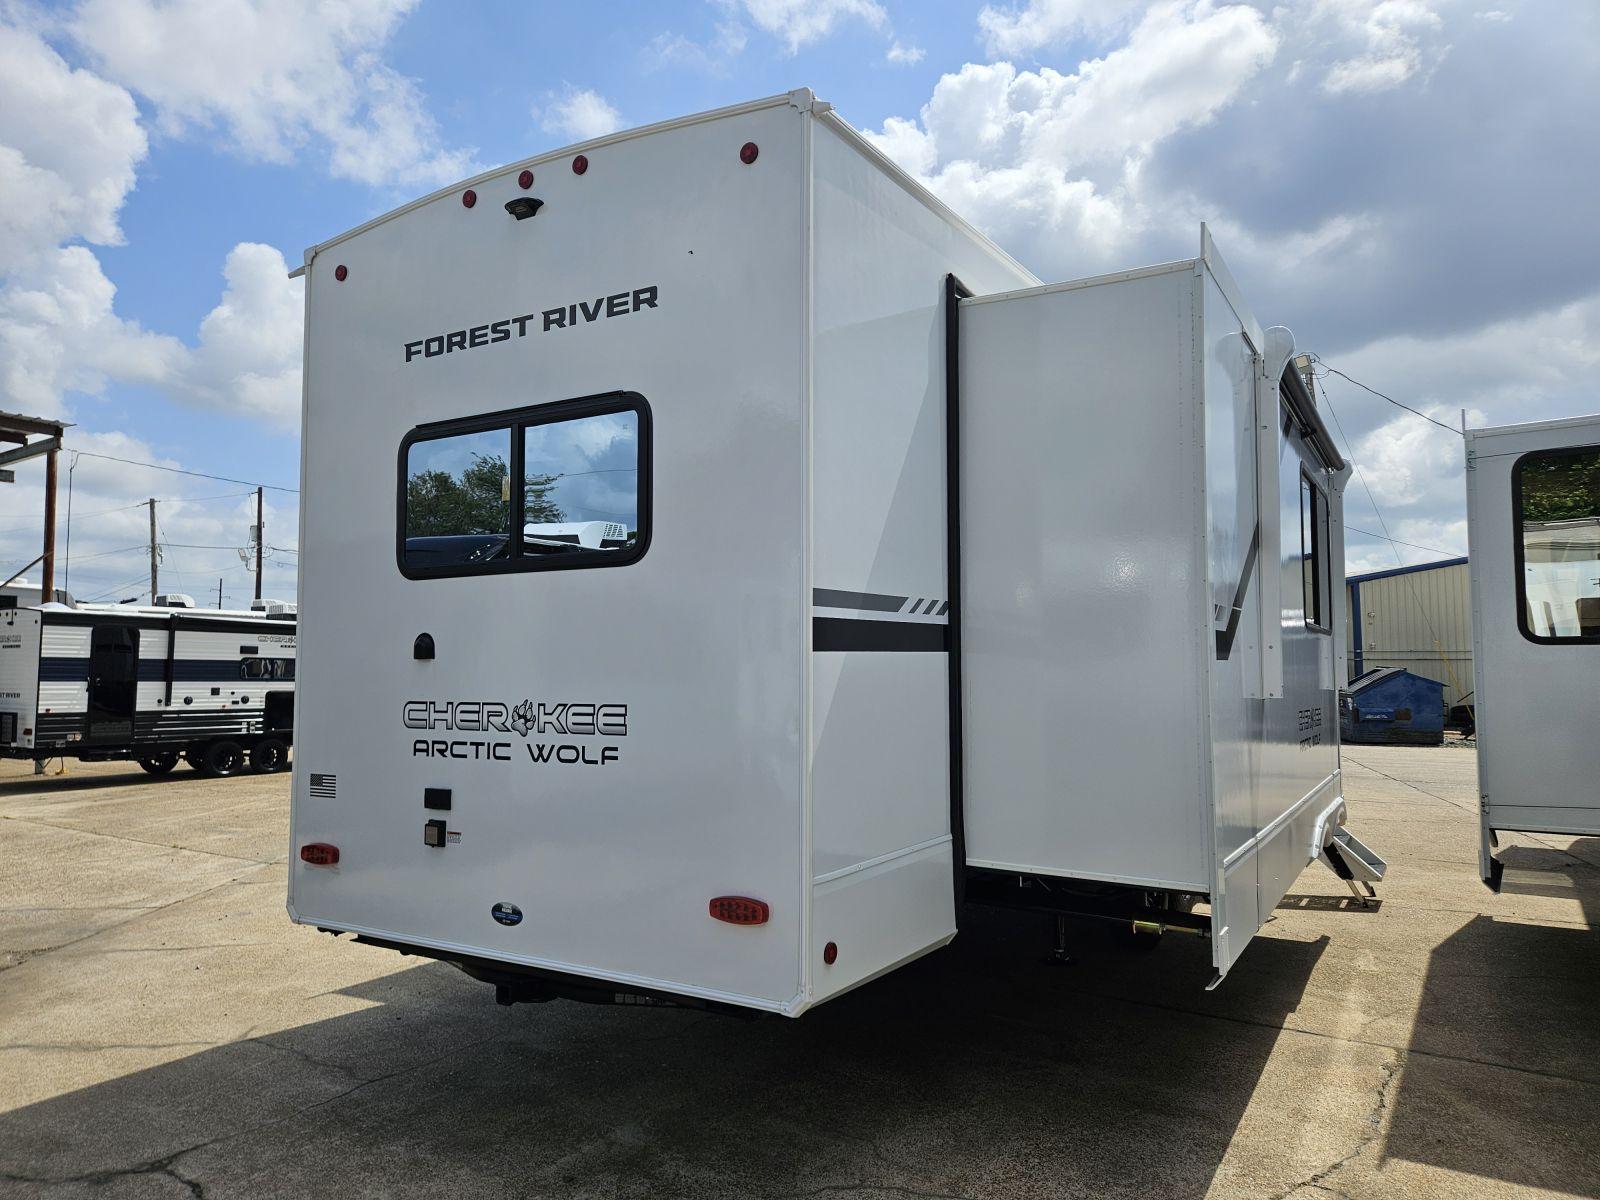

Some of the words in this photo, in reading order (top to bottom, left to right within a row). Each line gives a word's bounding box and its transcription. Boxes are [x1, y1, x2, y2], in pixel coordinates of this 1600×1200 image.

[404, 313, 534, 363] FOREST
[541, 285, 658, 332] RIVER
[413, 739, 512, 761] ARCTIC
[526, 743, 619, 765] WOLF
